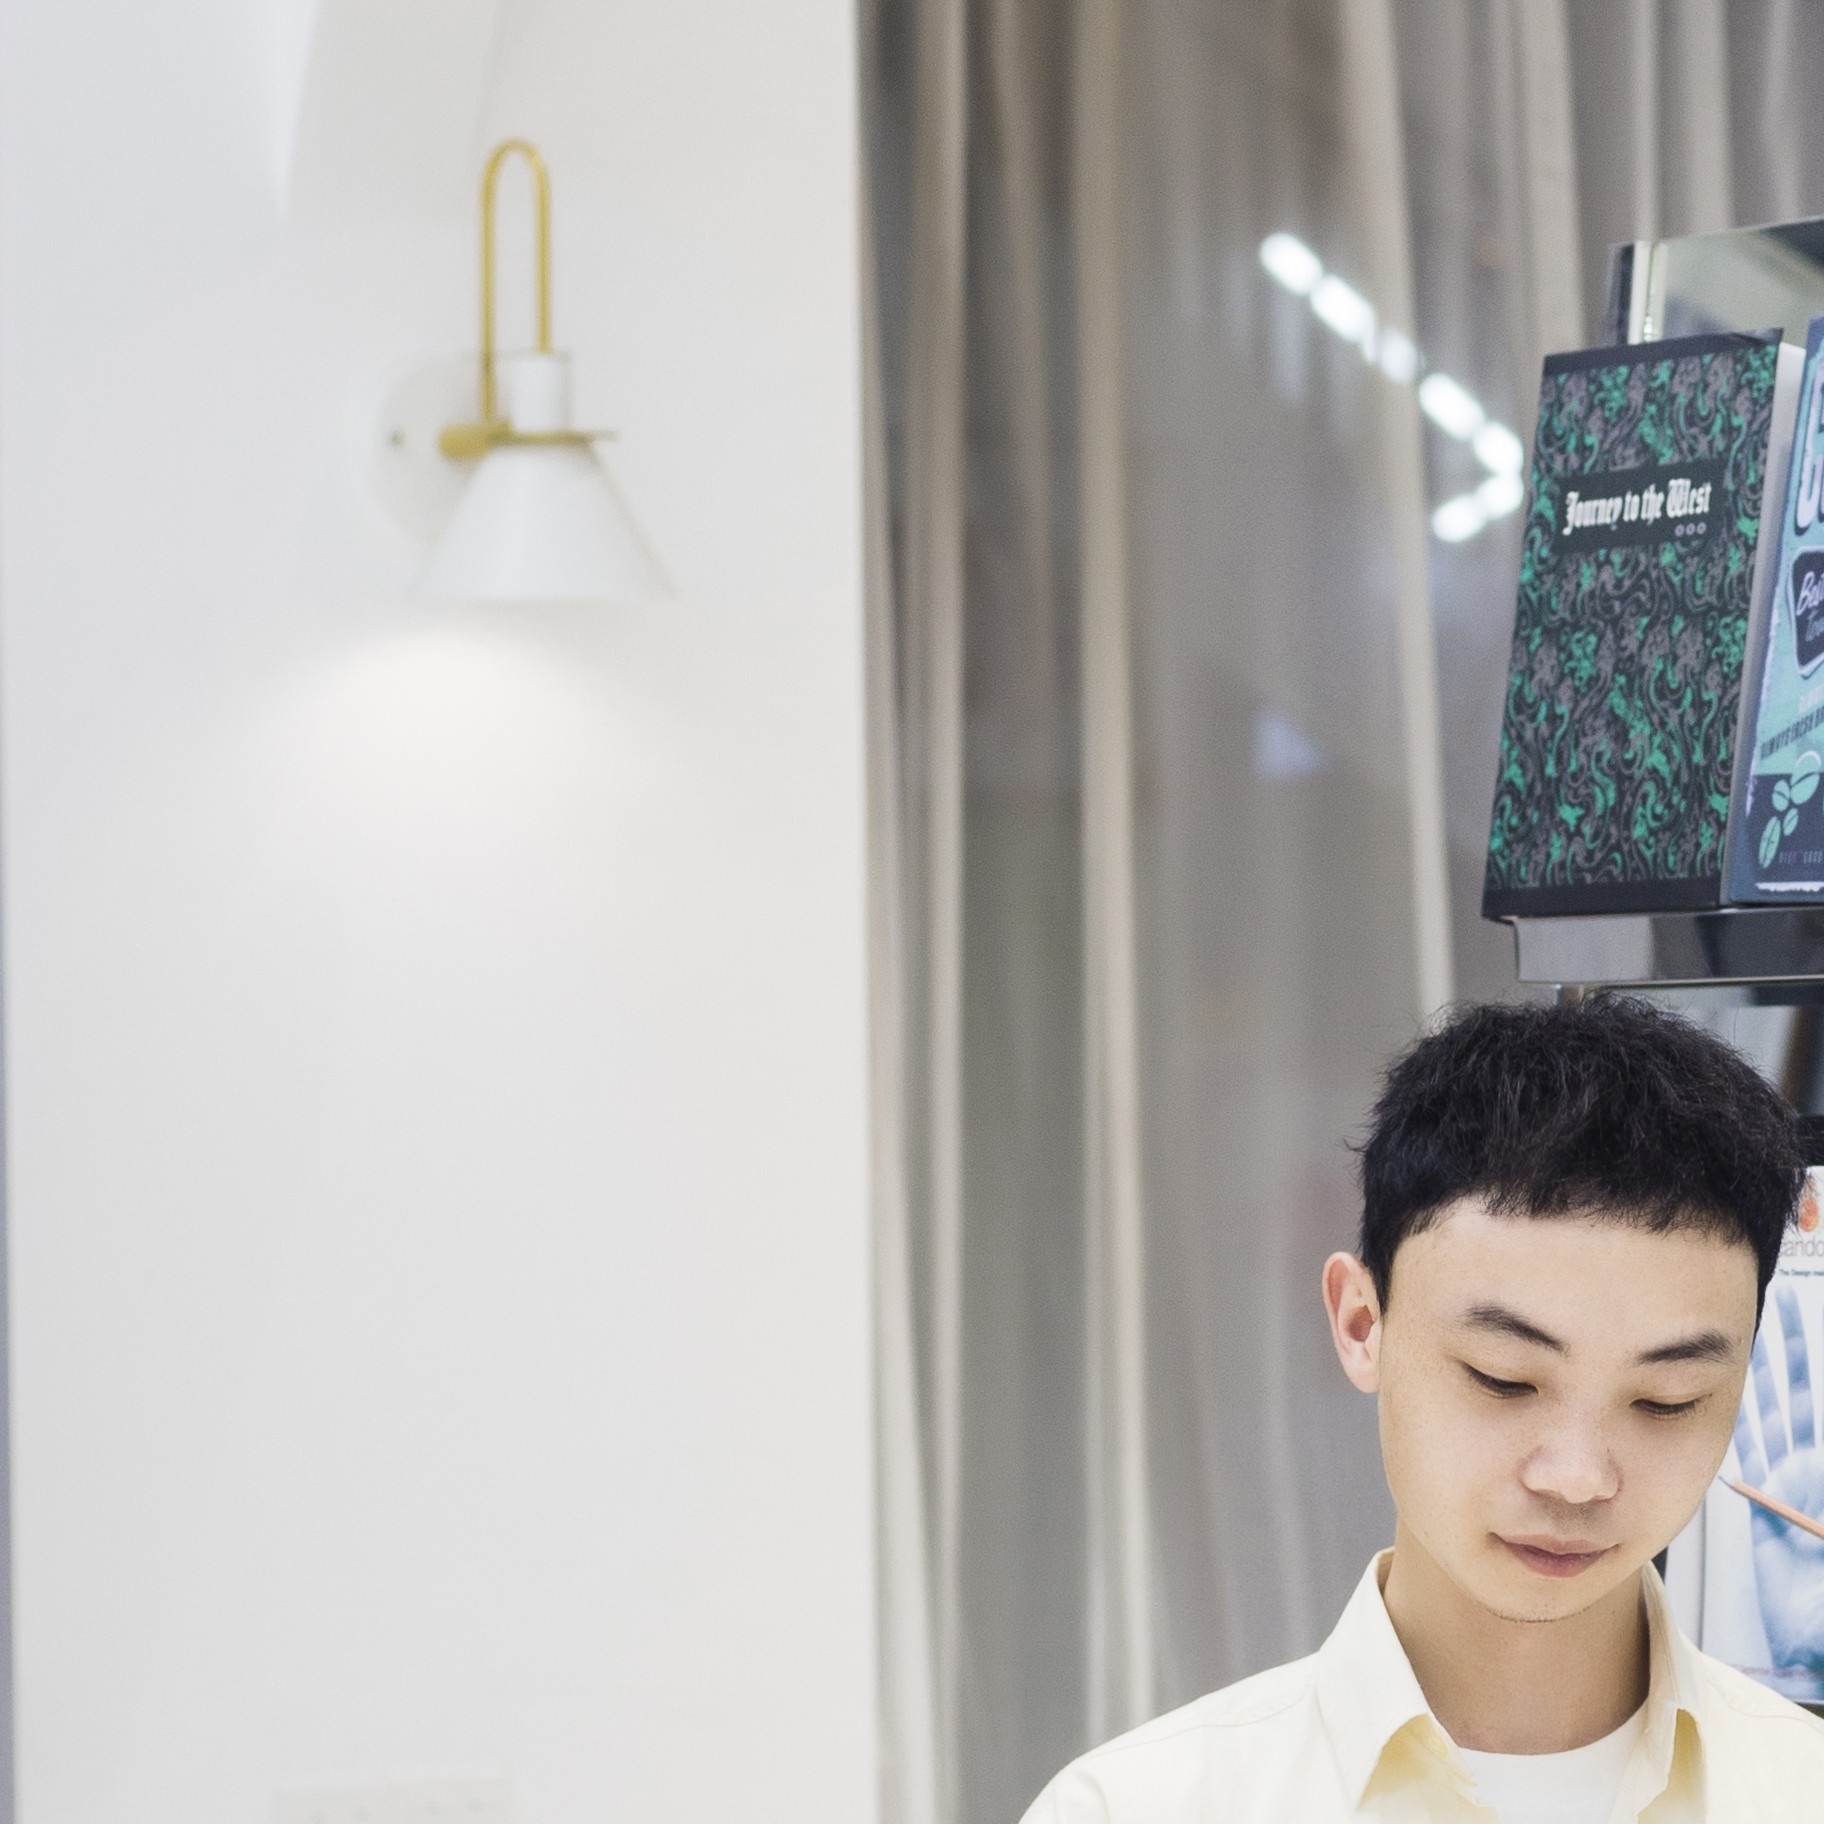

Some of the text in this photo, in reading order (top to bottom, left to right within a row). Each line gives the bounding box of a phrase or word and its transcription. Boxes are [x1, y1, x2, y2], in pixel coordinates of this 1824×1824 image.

[1562, 478, 1712, 536] Journey to the West
[1791, 1269, 1811, 1278] Design
